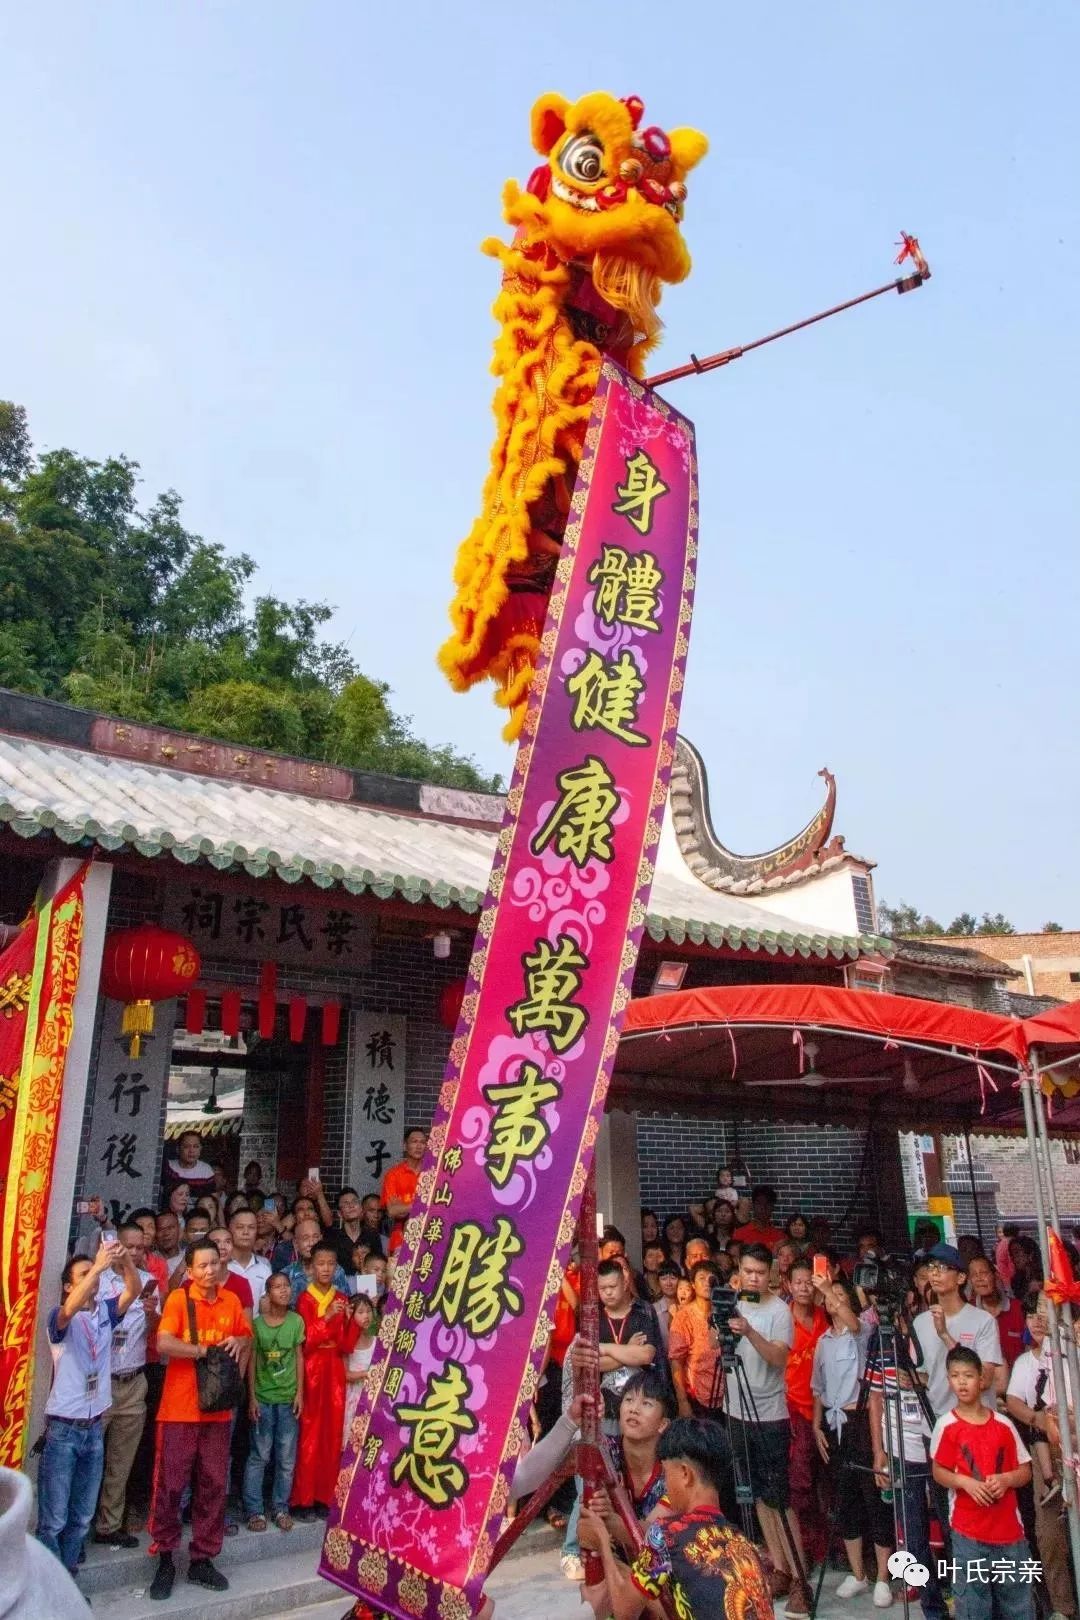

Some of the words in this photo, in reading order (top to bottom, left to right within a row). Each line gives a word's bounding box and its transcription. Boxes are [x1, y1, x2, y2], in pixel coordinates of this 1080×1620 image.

[533, 451, 668, 866] 身體健康
[173, 945, 195, 977] 福
[392, 936, 589, 1508] 萬事勝意
[364, 1435, 382, 1470] 賀
